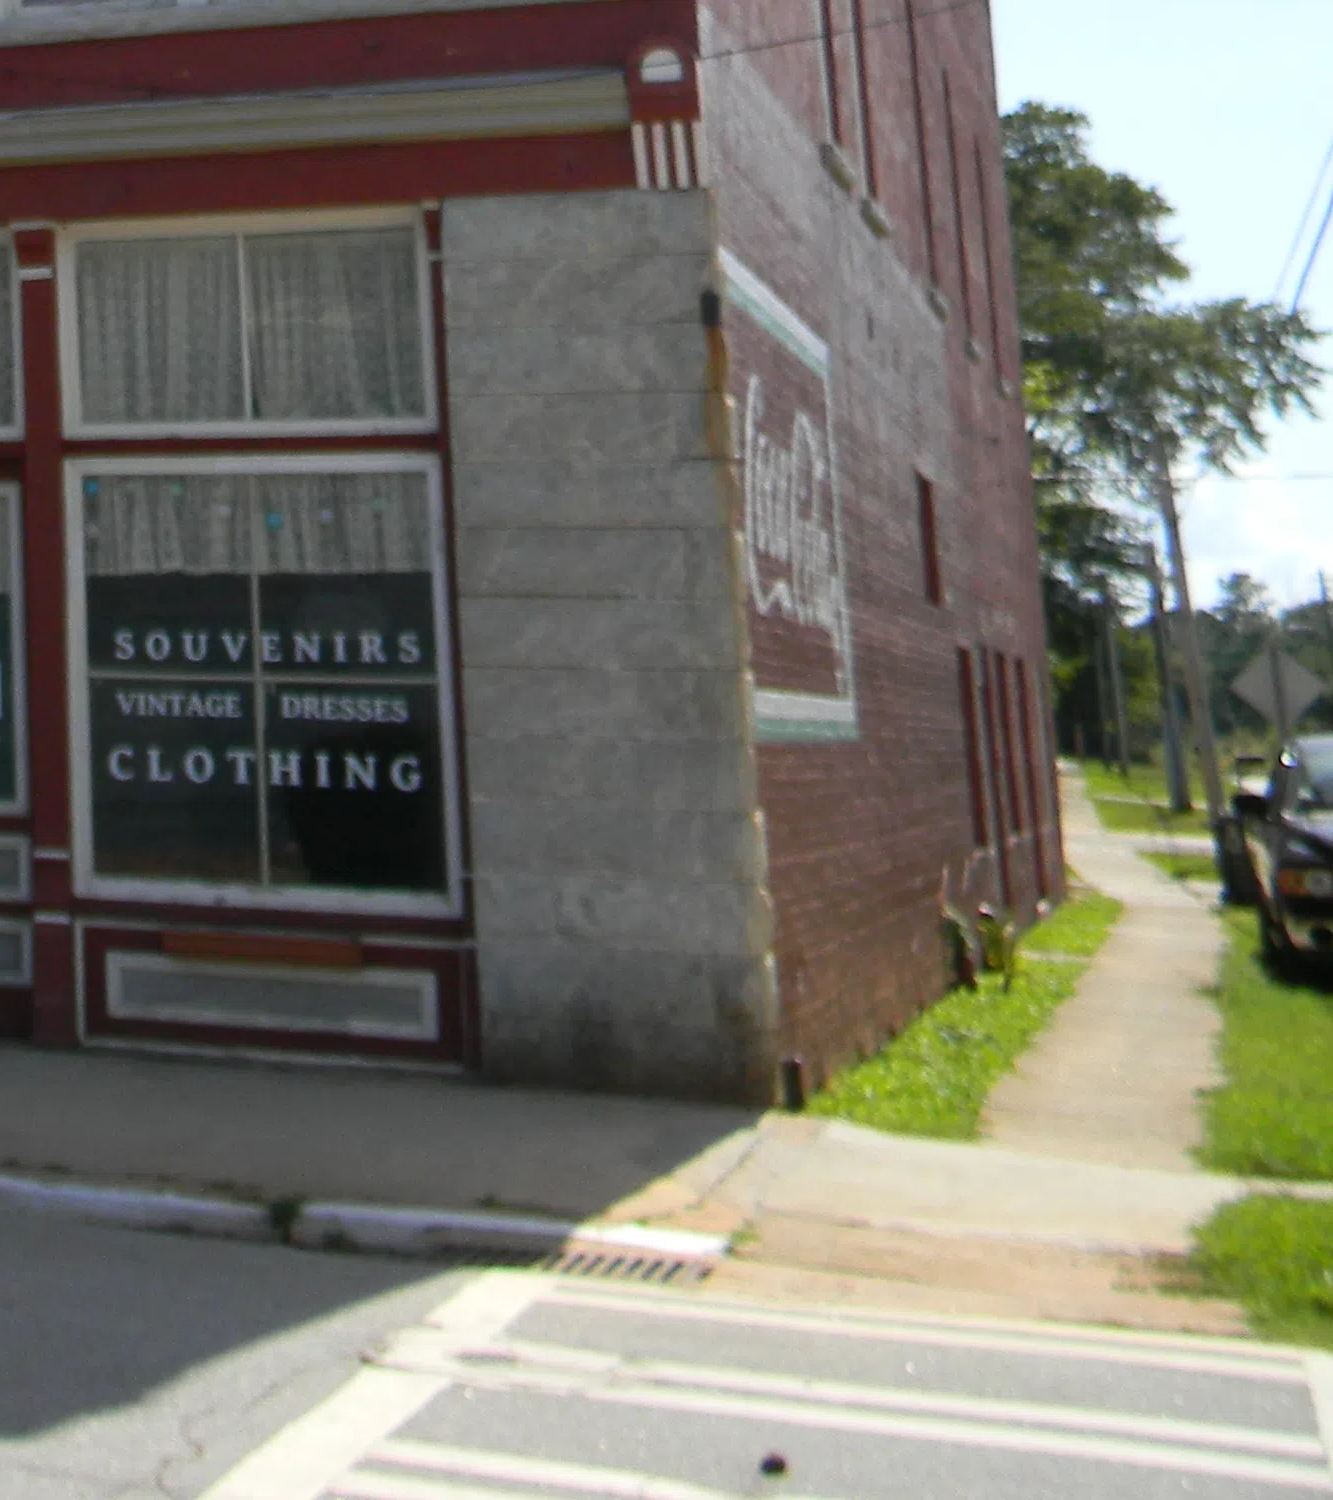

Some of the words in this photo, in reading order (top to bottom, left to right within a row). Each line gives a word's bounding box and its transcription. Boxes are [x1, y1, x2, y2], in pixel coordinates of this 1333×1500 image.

[113, 631, 421, 664] SOUVENIRS
[115, 692, 243, 719] VINTAGE
[281, 695, 410, 724] DRESSES
[108, 748, 423, 793] CLOTHING
